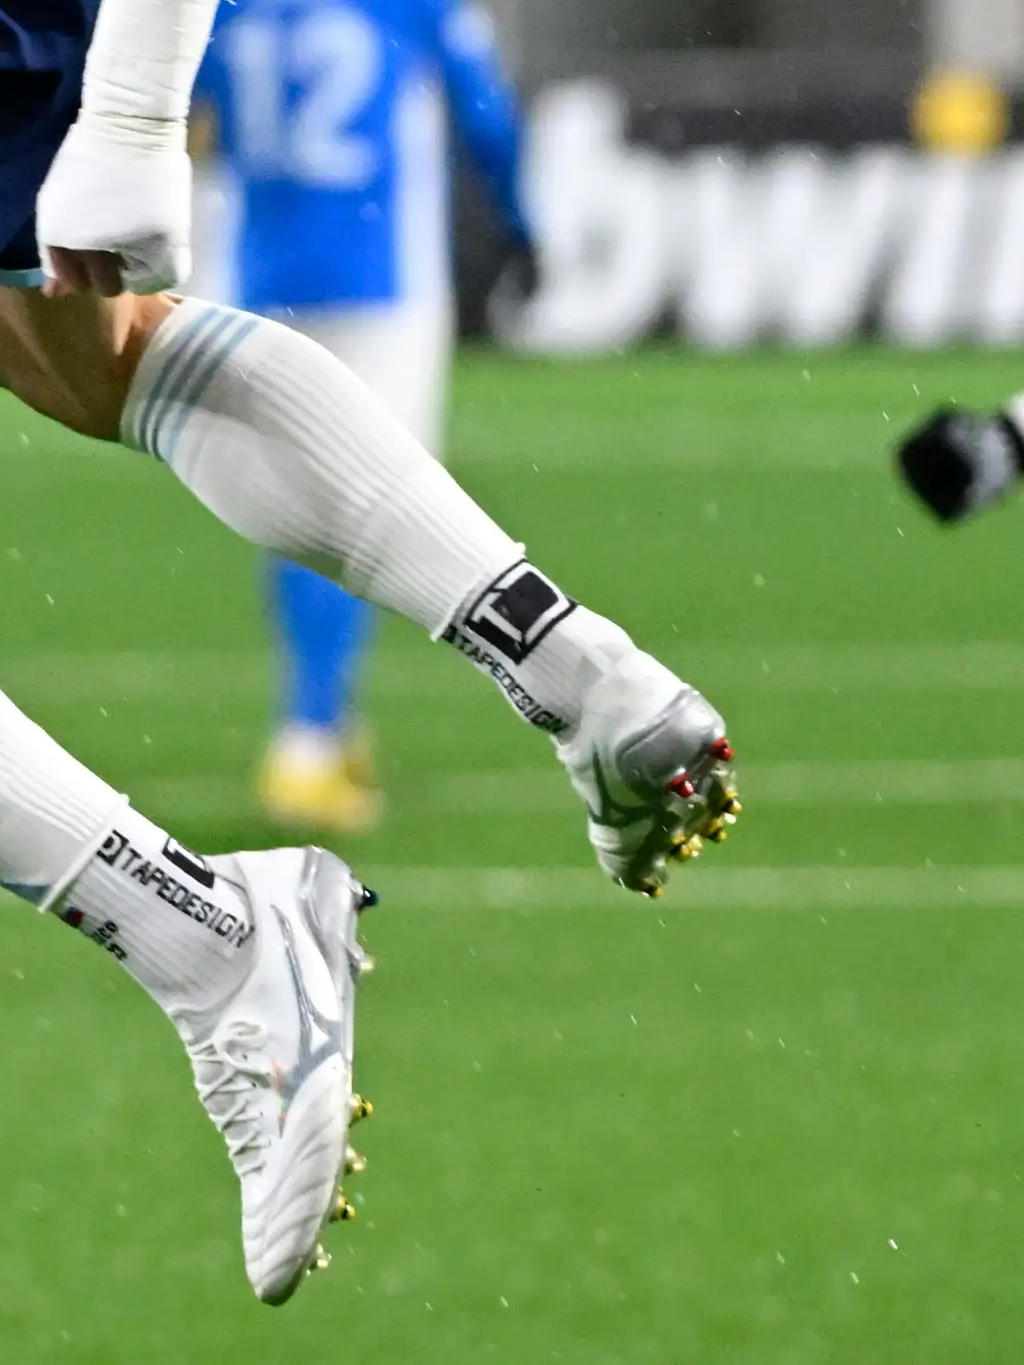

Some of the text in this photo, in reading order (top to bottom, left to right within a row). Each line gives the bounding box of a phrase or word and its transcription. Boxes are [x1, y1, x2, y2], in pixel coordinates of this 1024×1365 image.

[222, 2, 384, 186] 12
[504, 76, 1024, 352] bwi
[121, 847, 256, 948] TAPEDESIGN
